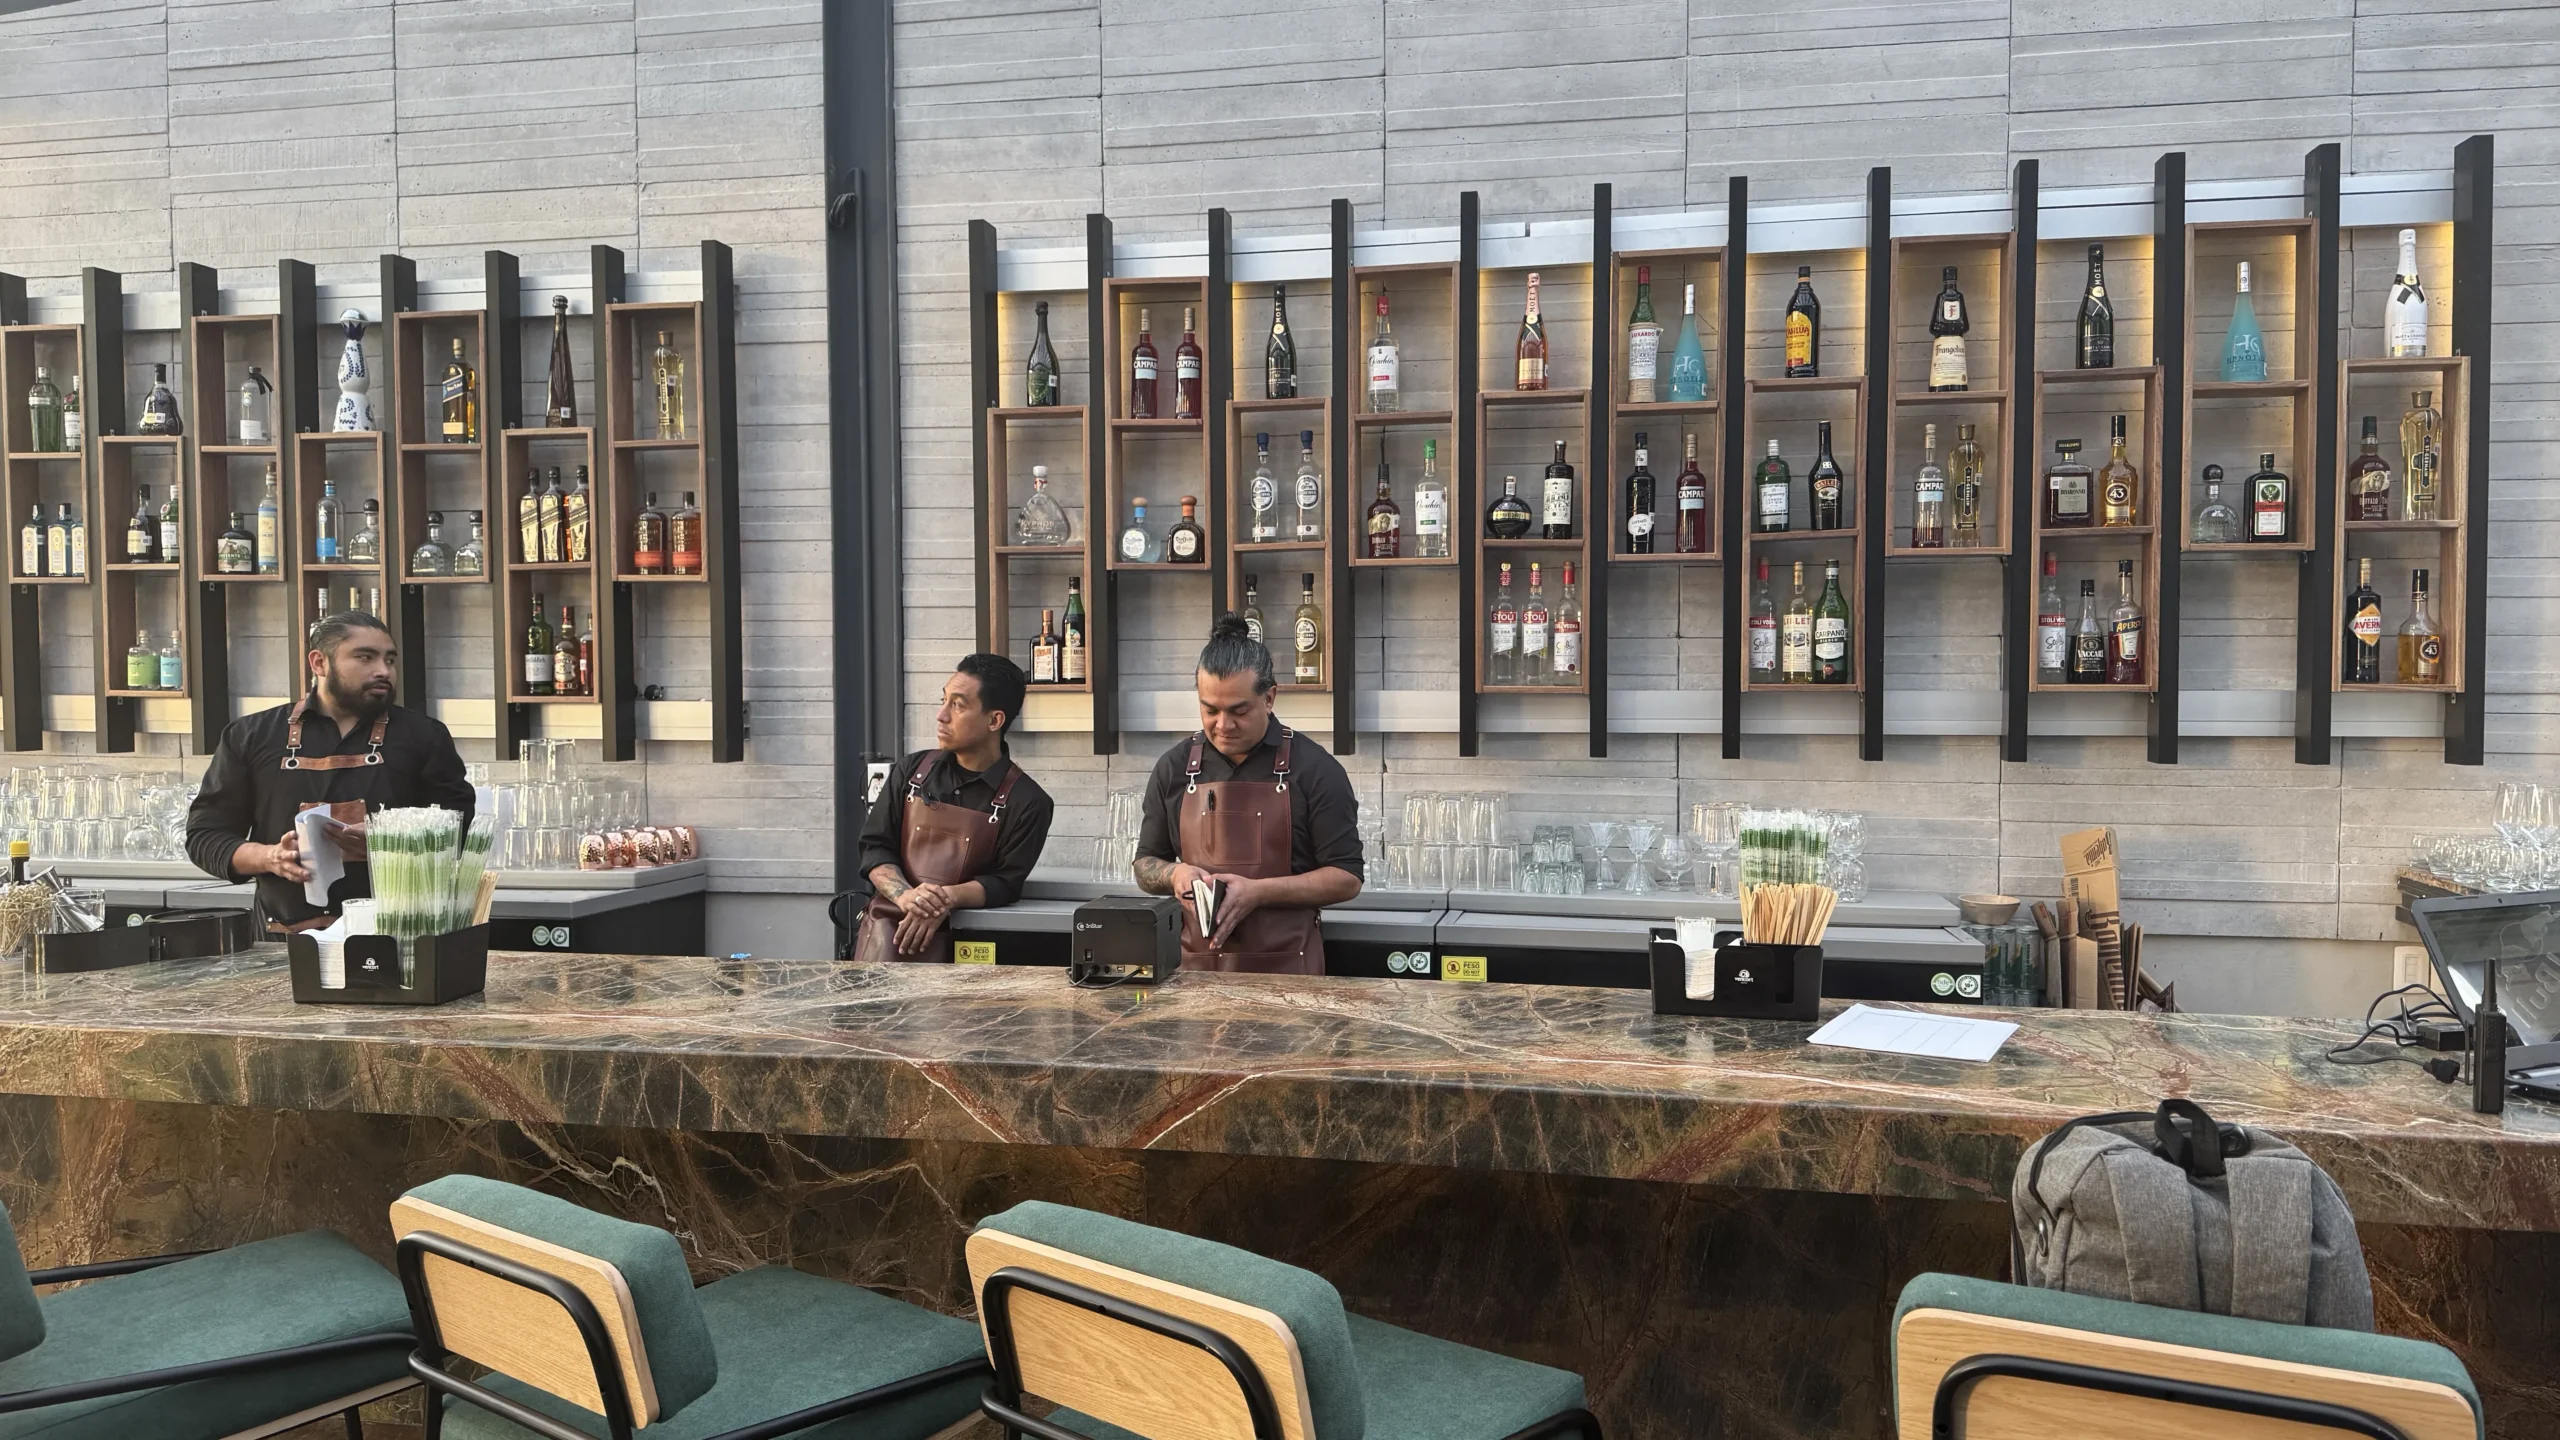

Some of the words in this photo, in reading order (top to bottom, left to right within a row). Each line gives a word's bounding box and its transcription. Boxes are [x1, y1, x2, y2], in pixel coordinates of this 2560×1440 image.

[1133, 361, 1157, 369] CAMPAR
[1176, 360, 1200, 368] CAMPAR
[1916, 482, 1944, 491] CAMPAR
[1678, 490, 1705, 499] CAMPAR
[2109, 488, 2124, 499] 43
[2359, 497, 2378, 505] BFFALO
[2354, 621, 2381, 630] AVERN
[1815, 629, 1845, 639] CARPANO
[2424, 644, 2438, 655] 43
